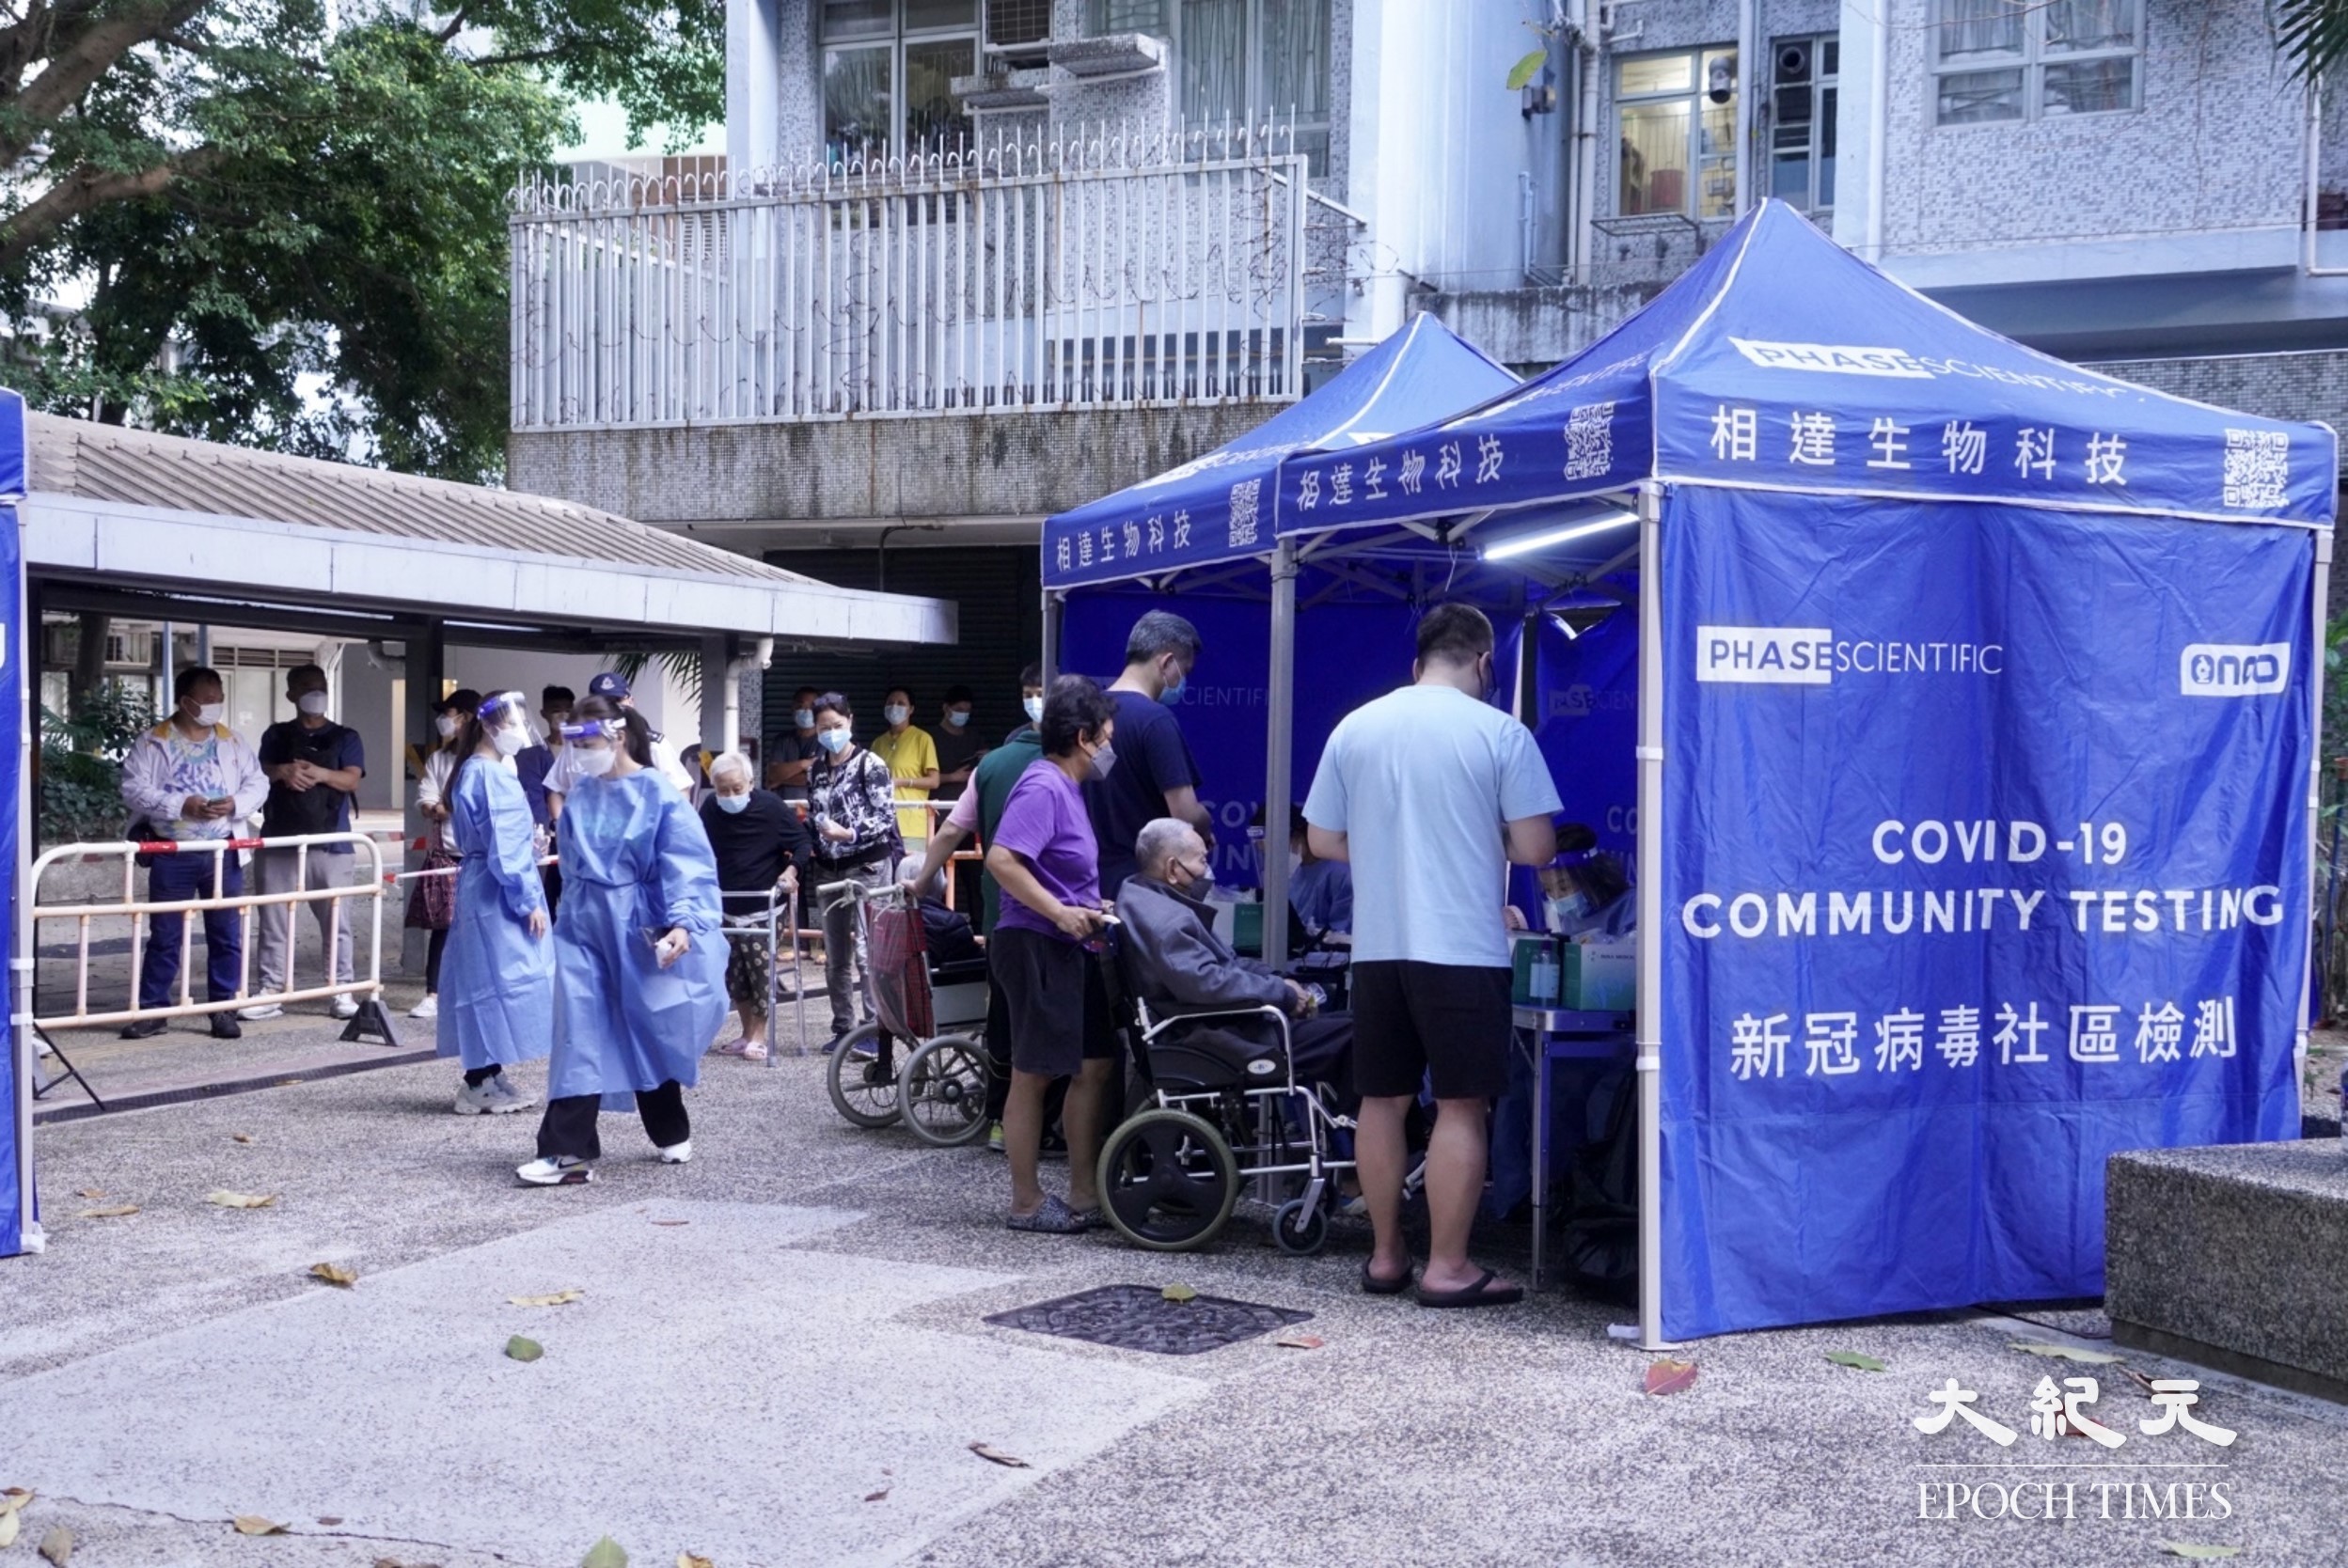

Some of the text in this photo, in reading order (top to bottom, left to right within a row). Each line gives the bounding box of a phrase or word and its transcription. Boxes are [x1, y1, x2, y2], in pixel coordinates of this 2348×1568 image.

[1296, 433, 1505, 512] 相達生物科技
[1710, 404, 2129, 488] 相達生物科技
[1056, 509, 1191, 572] 相達生物科技
[1872, 819, 2128, 866] COVID-19
[1682, 885, 2285, 939] COMMUNITY TESTING
[1730, 996, 2237, 1081] 新冠病毒社區檢測
